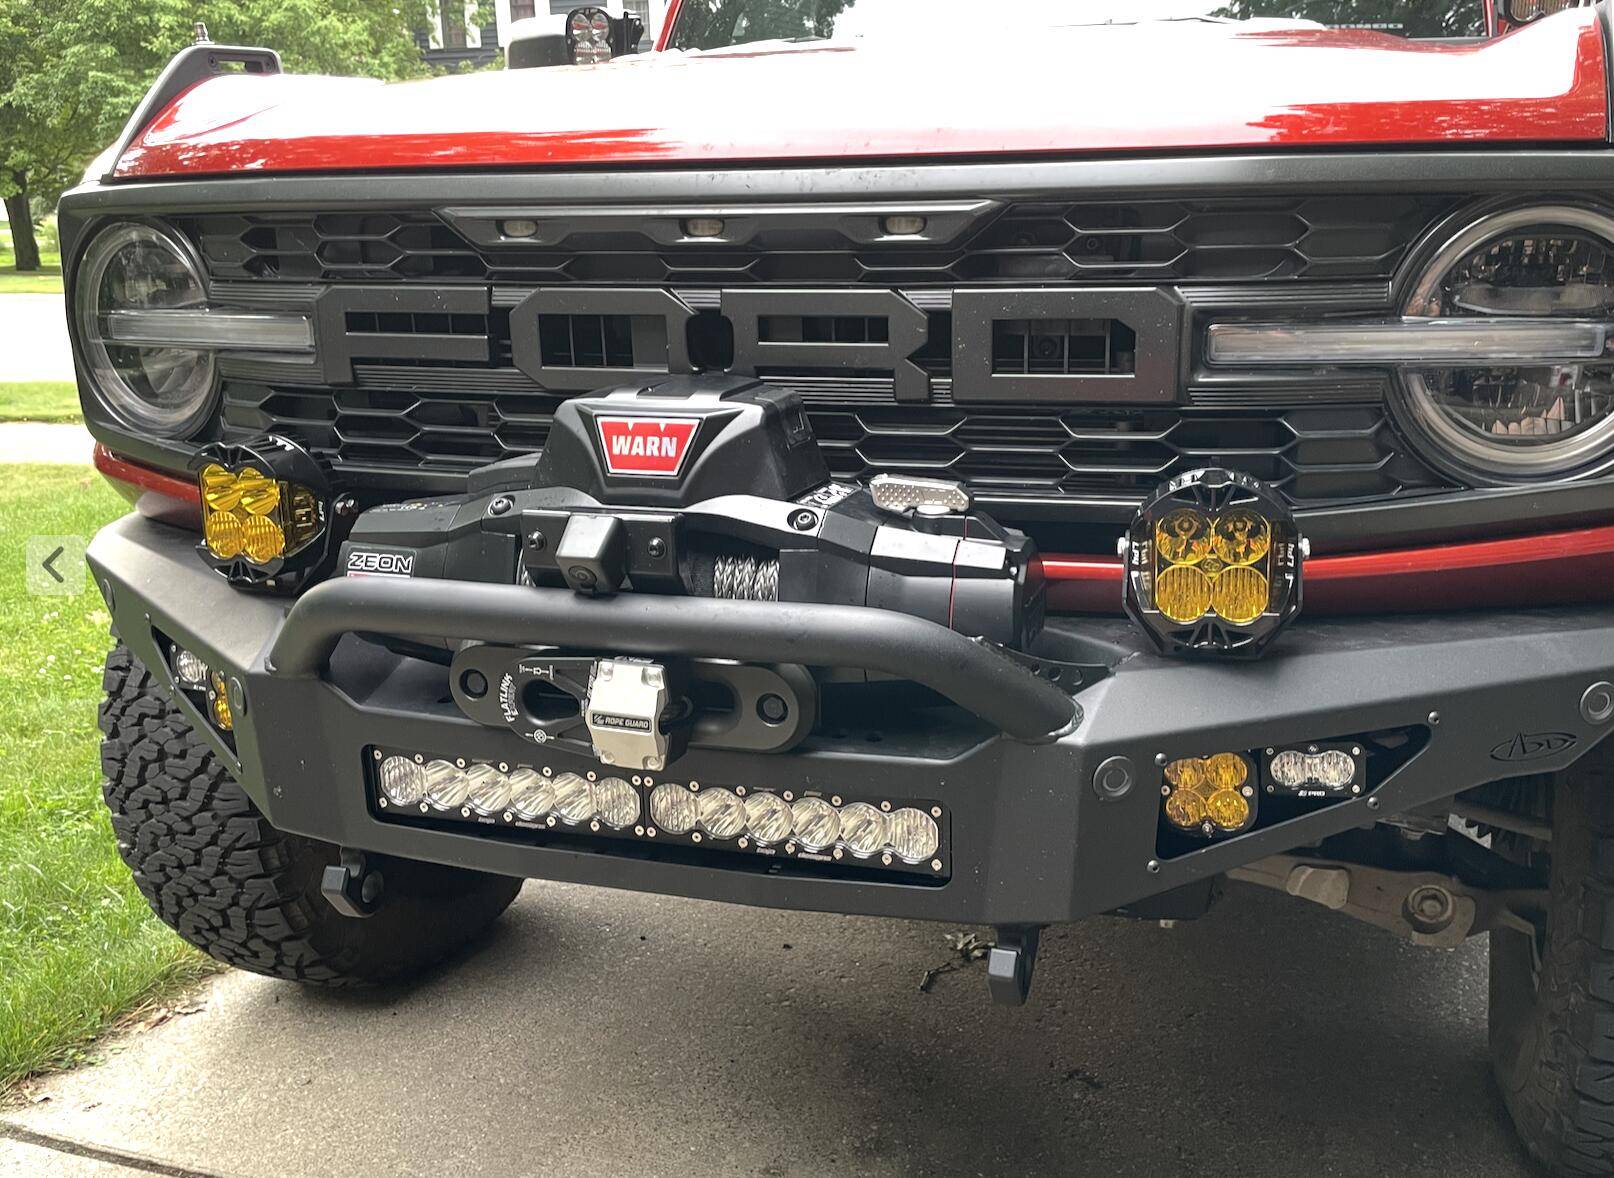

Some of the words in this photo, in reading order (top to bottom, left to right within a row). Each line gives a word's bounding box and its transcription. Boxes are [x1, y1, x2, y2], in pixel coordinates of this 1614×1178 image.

[317, 285, 1179, 402] FORD
[612, 434, 678, 457] WARN
[348, 552, 414, 574] ZEON
[1287, 543, 1295, 568] LP4
[500, 672, 515, 723] FLATLINK
[605, 716, 624, 726] ROPE
[625, 719, 649, 729] GUARD
